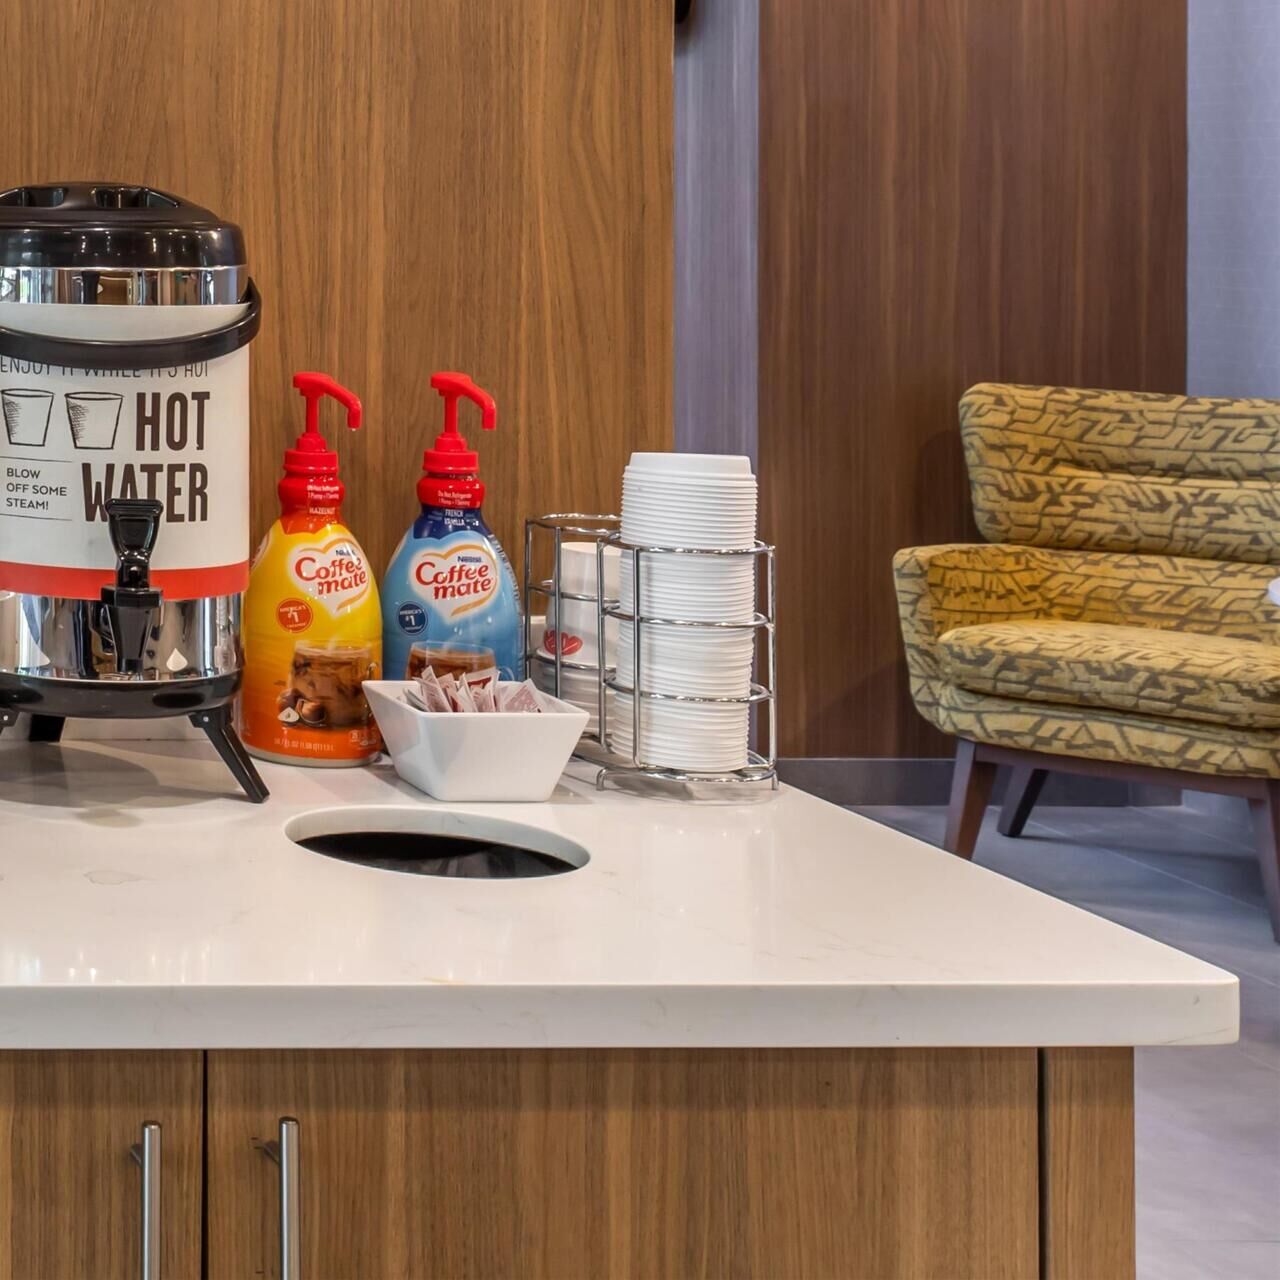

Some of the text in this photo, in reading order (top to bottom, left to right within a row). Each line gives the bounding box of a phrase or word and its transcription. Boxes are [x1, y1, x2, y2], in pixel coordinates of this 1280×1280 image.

[136, 391, 210, 451] HOT
[6, 467, 41, 479] BLOW
[6, 482, 68, 496] OFF SOME
[81, 462, 208, 523] WATER
[6, 497, 49, 510] STEAM!
[295, 556, 363, 582] Coffee
[415, 561, 489, 586] Coffee
[317, 571, 366, 596] mate
[433, 578, 492, 600] mate
